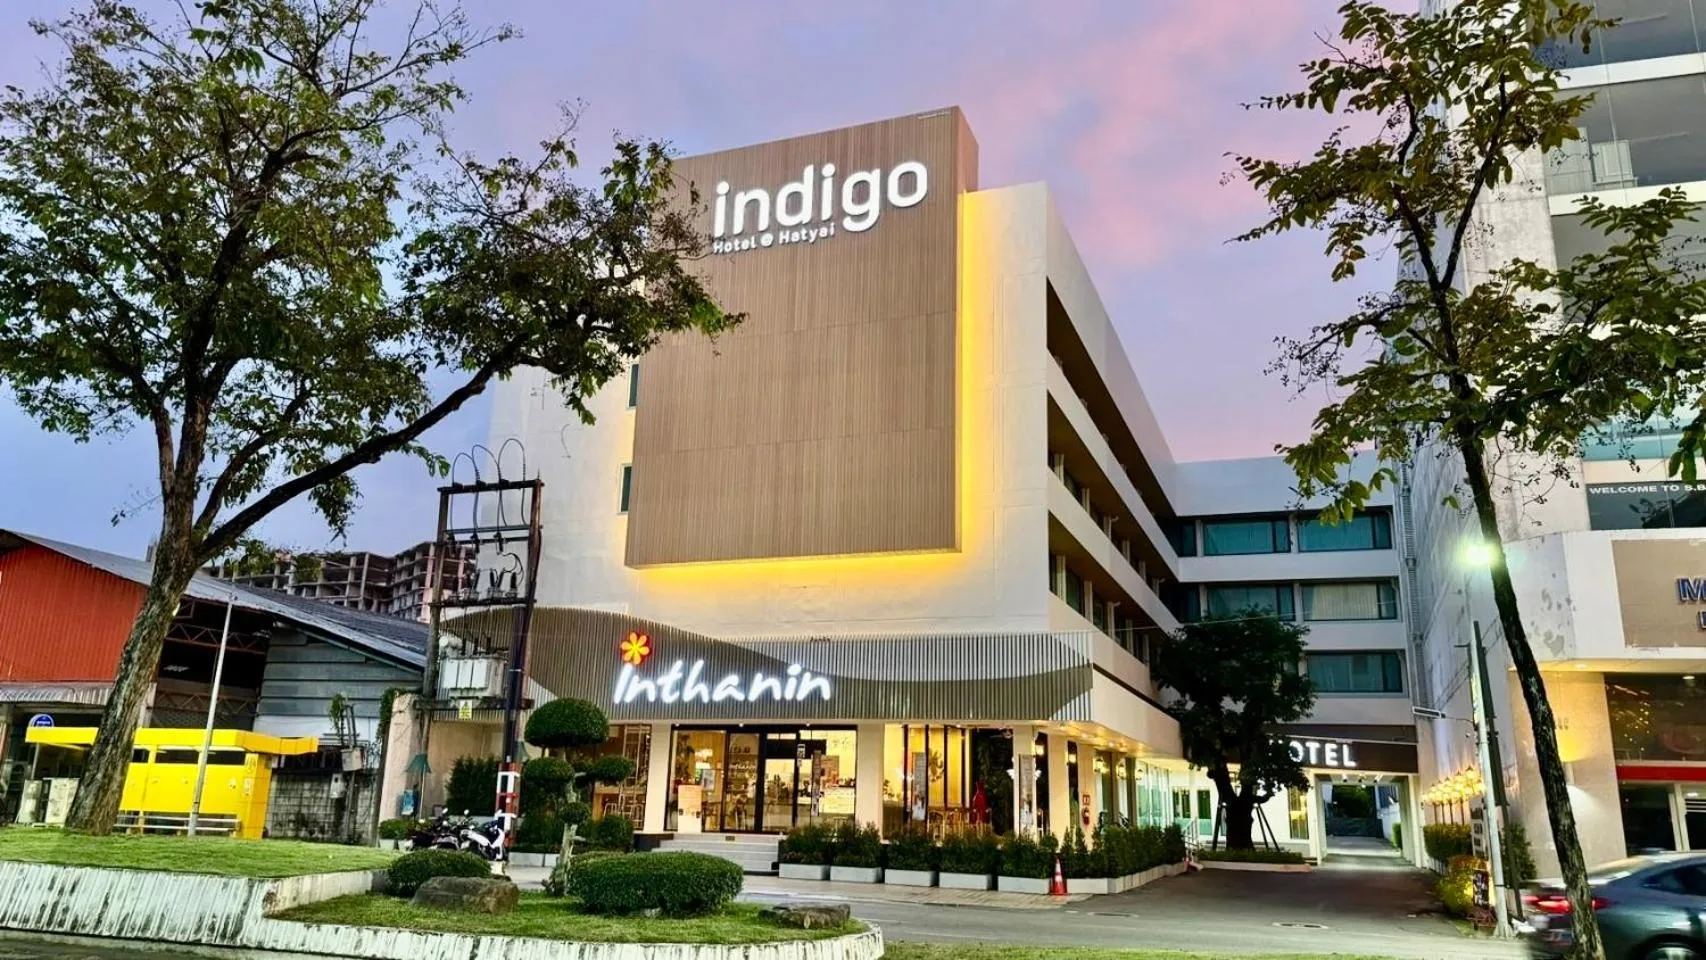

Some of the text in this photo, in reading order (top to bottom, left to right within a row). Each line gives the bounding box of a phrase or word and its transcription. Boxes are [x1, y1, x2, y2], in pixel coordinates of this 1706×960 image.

[714, 162, 928, 238] indigo
[713, 222, 836, 254] Hotel @ Hatyai
[1589, 485, 1657, 494] WELCOME
[613, 659, 831, 704] Inthanin
[1268, 739, 1357, 767] OTEL
